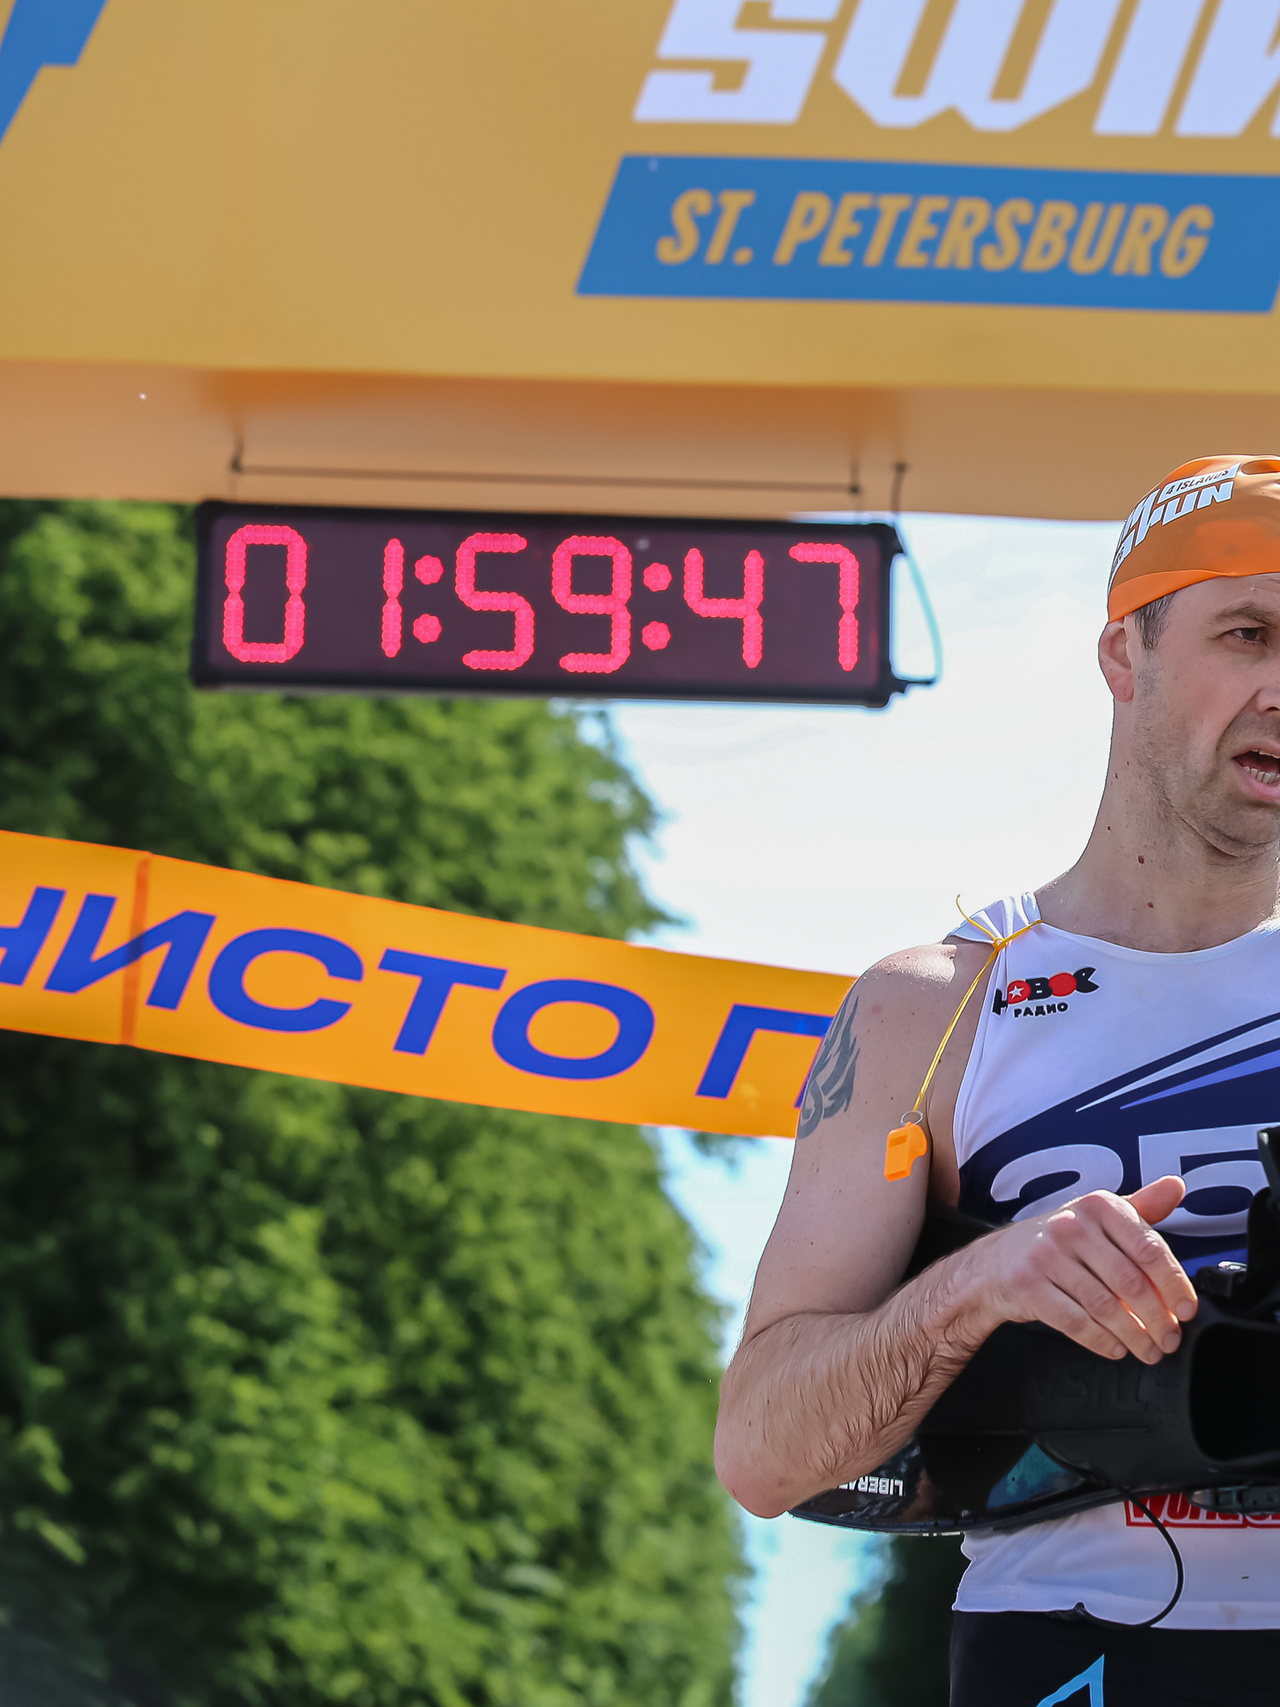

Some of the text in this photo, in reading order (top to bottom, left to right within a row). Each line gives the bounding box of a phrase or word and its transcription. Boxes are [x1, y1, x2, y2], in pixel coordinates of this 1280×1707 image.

[656, 188, 1215, 278] ST. PETERSBURG
[1166, 484, 1176, 495] 4
[1013, 1002, 1069, 1018] РАДИО
